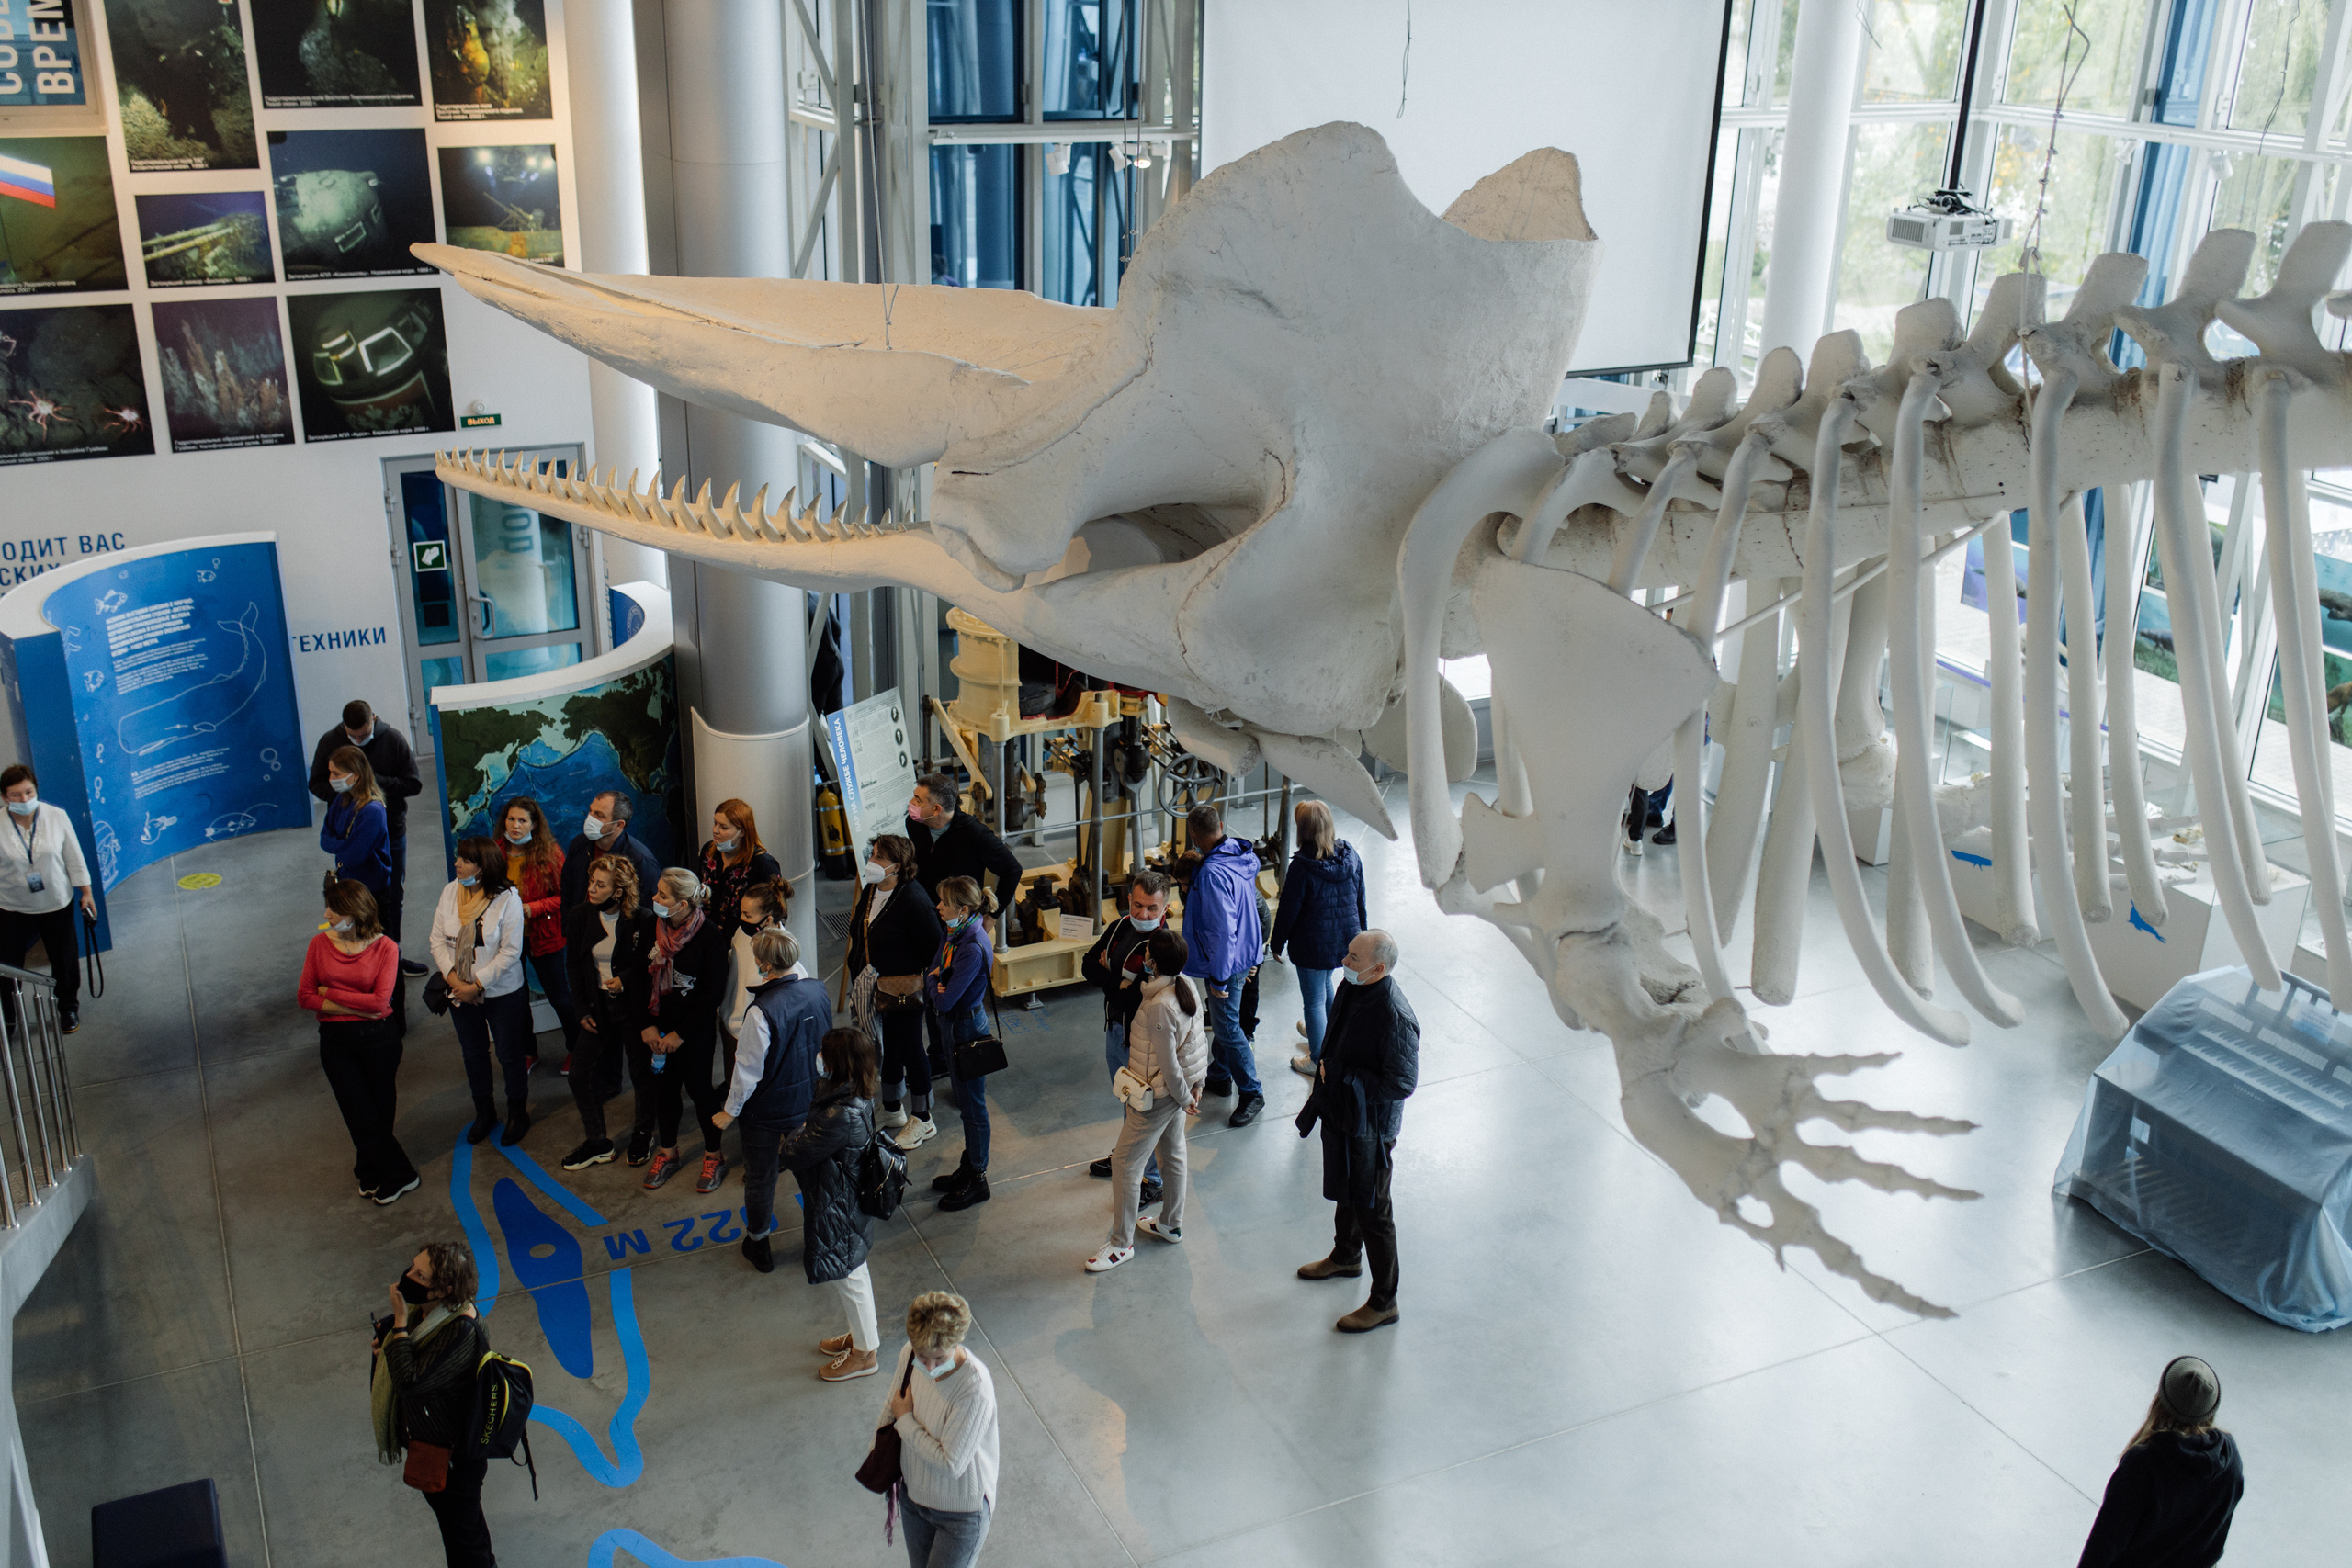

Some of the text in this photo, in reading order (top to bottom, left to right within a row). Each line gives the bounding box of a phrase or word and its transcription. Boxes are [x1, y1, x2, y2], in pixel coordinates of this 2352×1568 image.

[467, 416, 495, 425] ВЫХОД
[2, 532, 125, 562] ОДИТ ВАС
[292, 627, 386, 652] ЕХНИКИ
[833, 717, 848, 764] ЧЕЛОВЕКА
[842, 764, 855, 801] СЛУЖБЕ
[481, 1384, 498, 1445] SKECHERS
